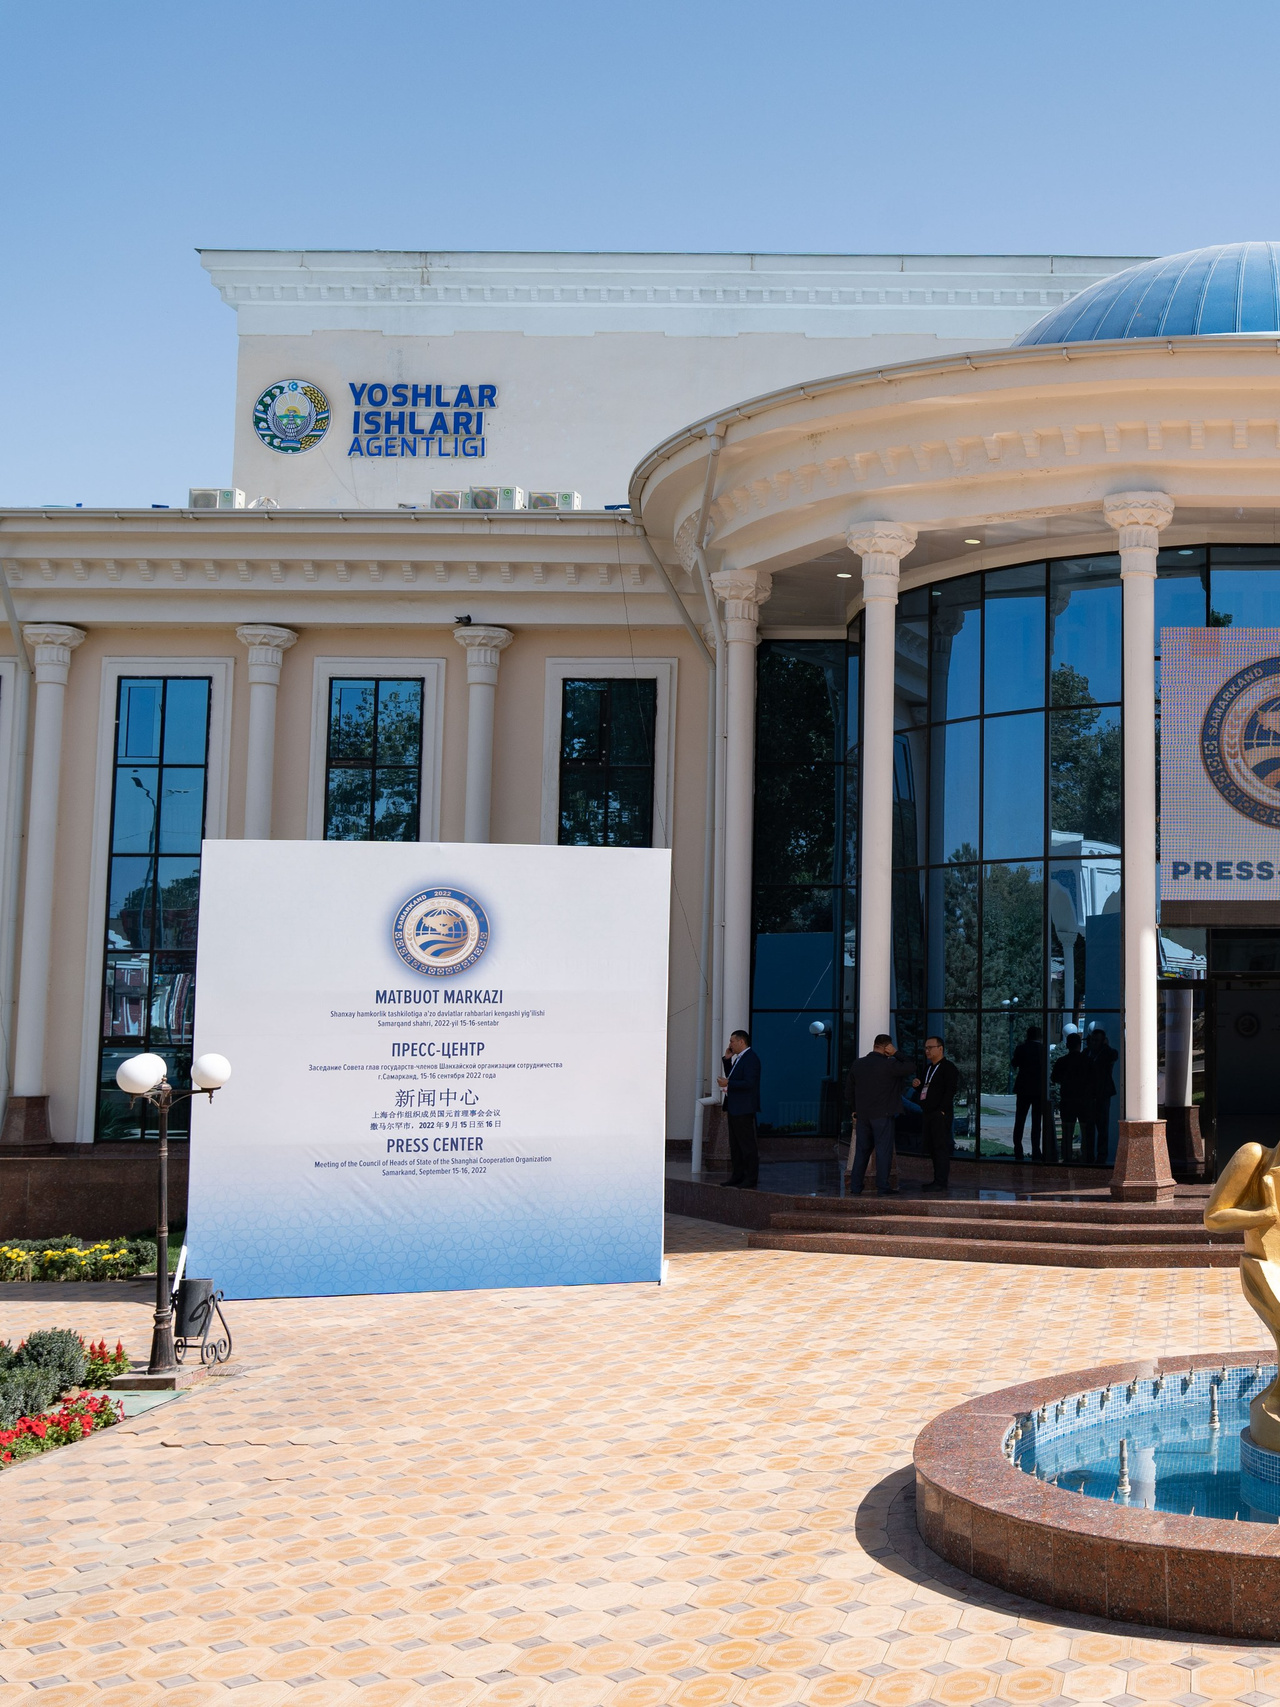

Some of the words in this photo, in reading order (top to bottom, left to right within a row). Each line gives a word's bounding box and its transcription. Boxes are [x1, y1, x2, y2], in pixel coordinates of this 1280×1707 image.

[348, 382, 497, 407] YOSHLAR
[352, 411, 484, 435] ISHLARI
[347, 437, 486, 457] AGENTLIGI
[1208, 666, 1264, 736] SAMARKAND
[397, 894, 427, 930] SAMARKAND
[376, 990, 440, 1004] MATBUOT
[444, 990, 503, 1004] MARKAZI
[330, 1010, 356, 1019] Shanxay
[388, 1010, 423, 1018] tashkilotiga
[494, 1010, 521, 1018] kengashi
[378, 1020, 412, 1028] Samarqand
[434, 1019, 459, 1028] 2022-yil
[392, 1042, 485, 1059] ПРЕСС-ЦЕНТР
[437, 1072, 465, 1080] сентября
[395, 1088, 479, 1108] 新闻中心
[387, 1138, 429, 1153] PRESS
[433, 1137, 484, 1152] CENTER
[314, 1161, 340, 1169] Meeting
[416, 1157, 432, 1166] State
[451, 1157, 479, 1166] Shanghai
[479, 1157, 515, 1166] Cooperation
[515, 1156, 552, 1164] Organization
[419, 1168, 451, 1176] September
